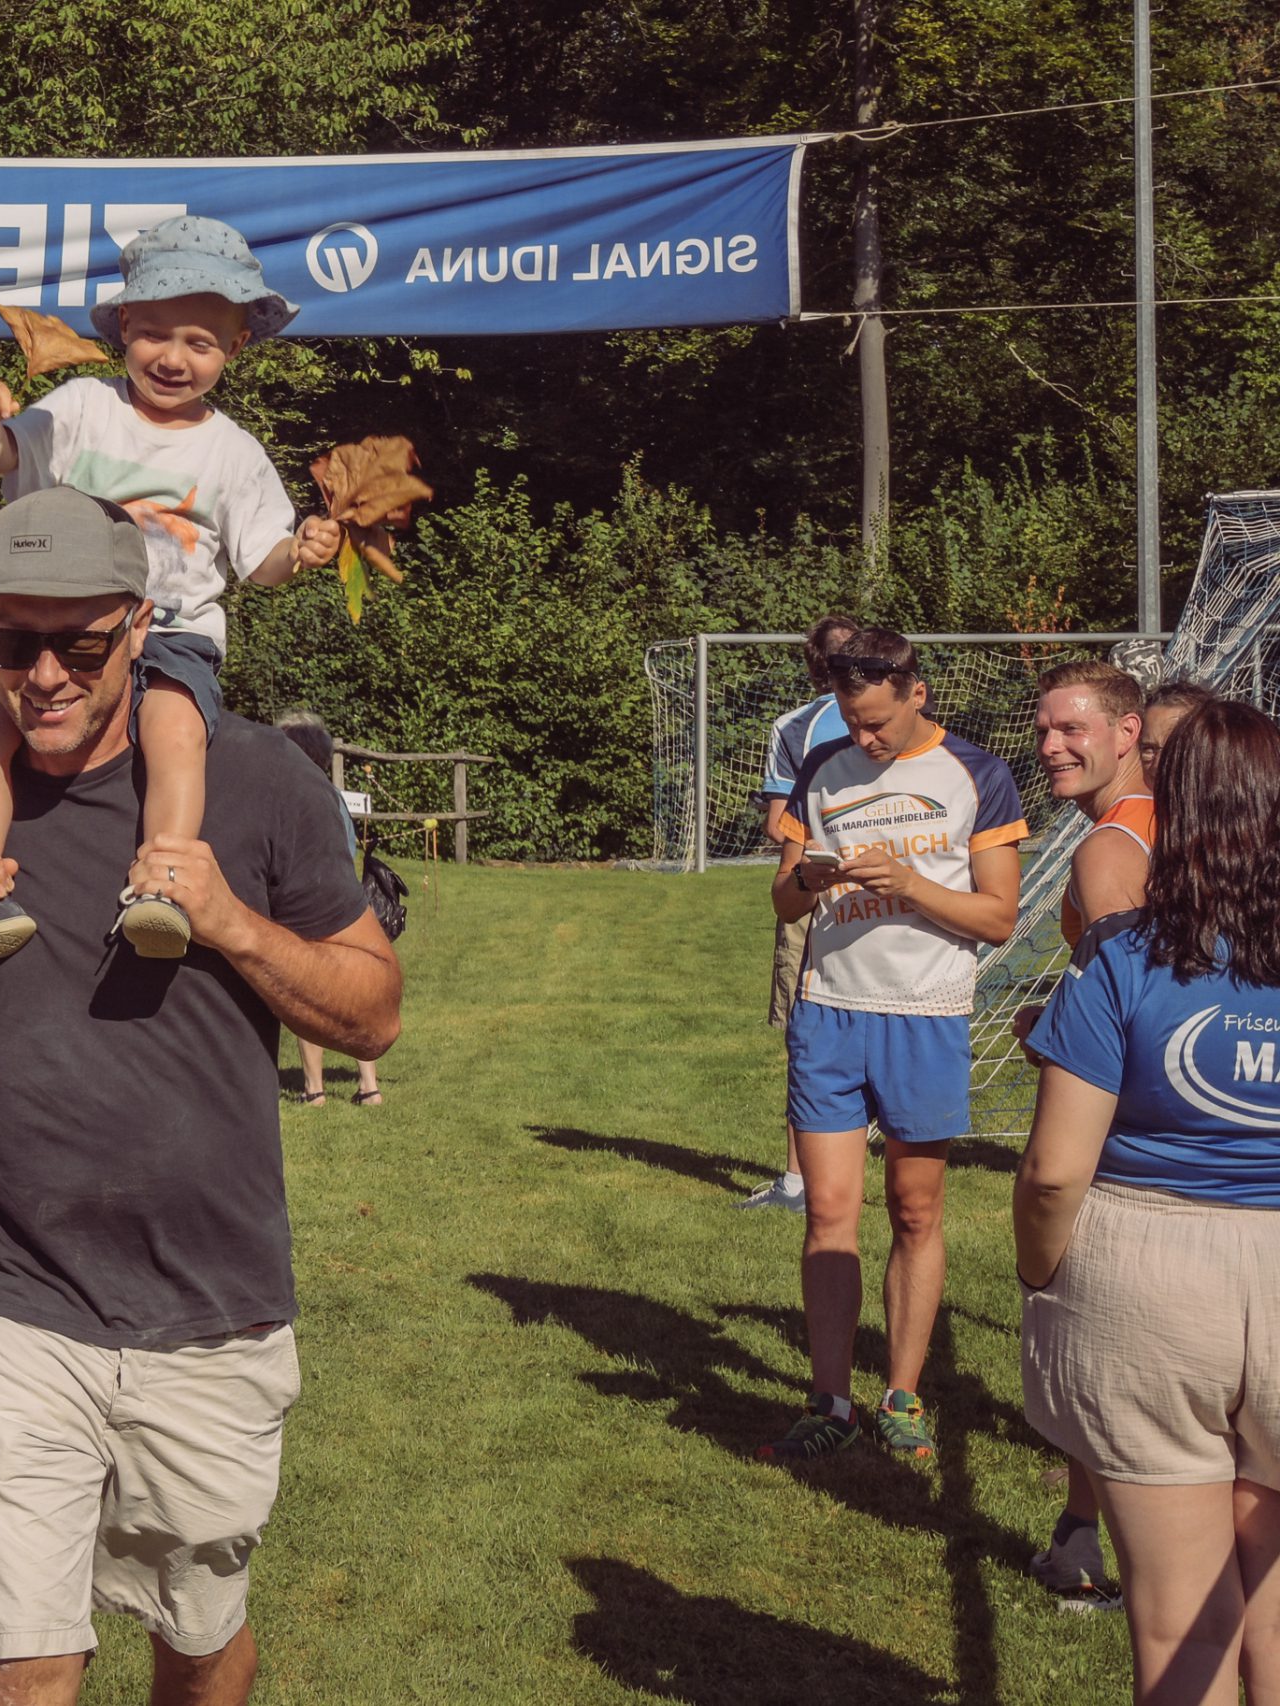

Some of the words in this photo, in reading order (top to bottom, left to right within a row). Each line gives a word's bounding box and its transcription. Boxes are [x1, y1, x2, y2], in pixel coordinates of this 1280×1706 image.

[13, 539, 37, 548] Hurley
[864, 799, 918, 818] GELITA
[842, 817, 892, 830] MARATHON
[894, 810, 948, 824] HEIDELBERG
[1233, 1041, 1280, 1083] M
